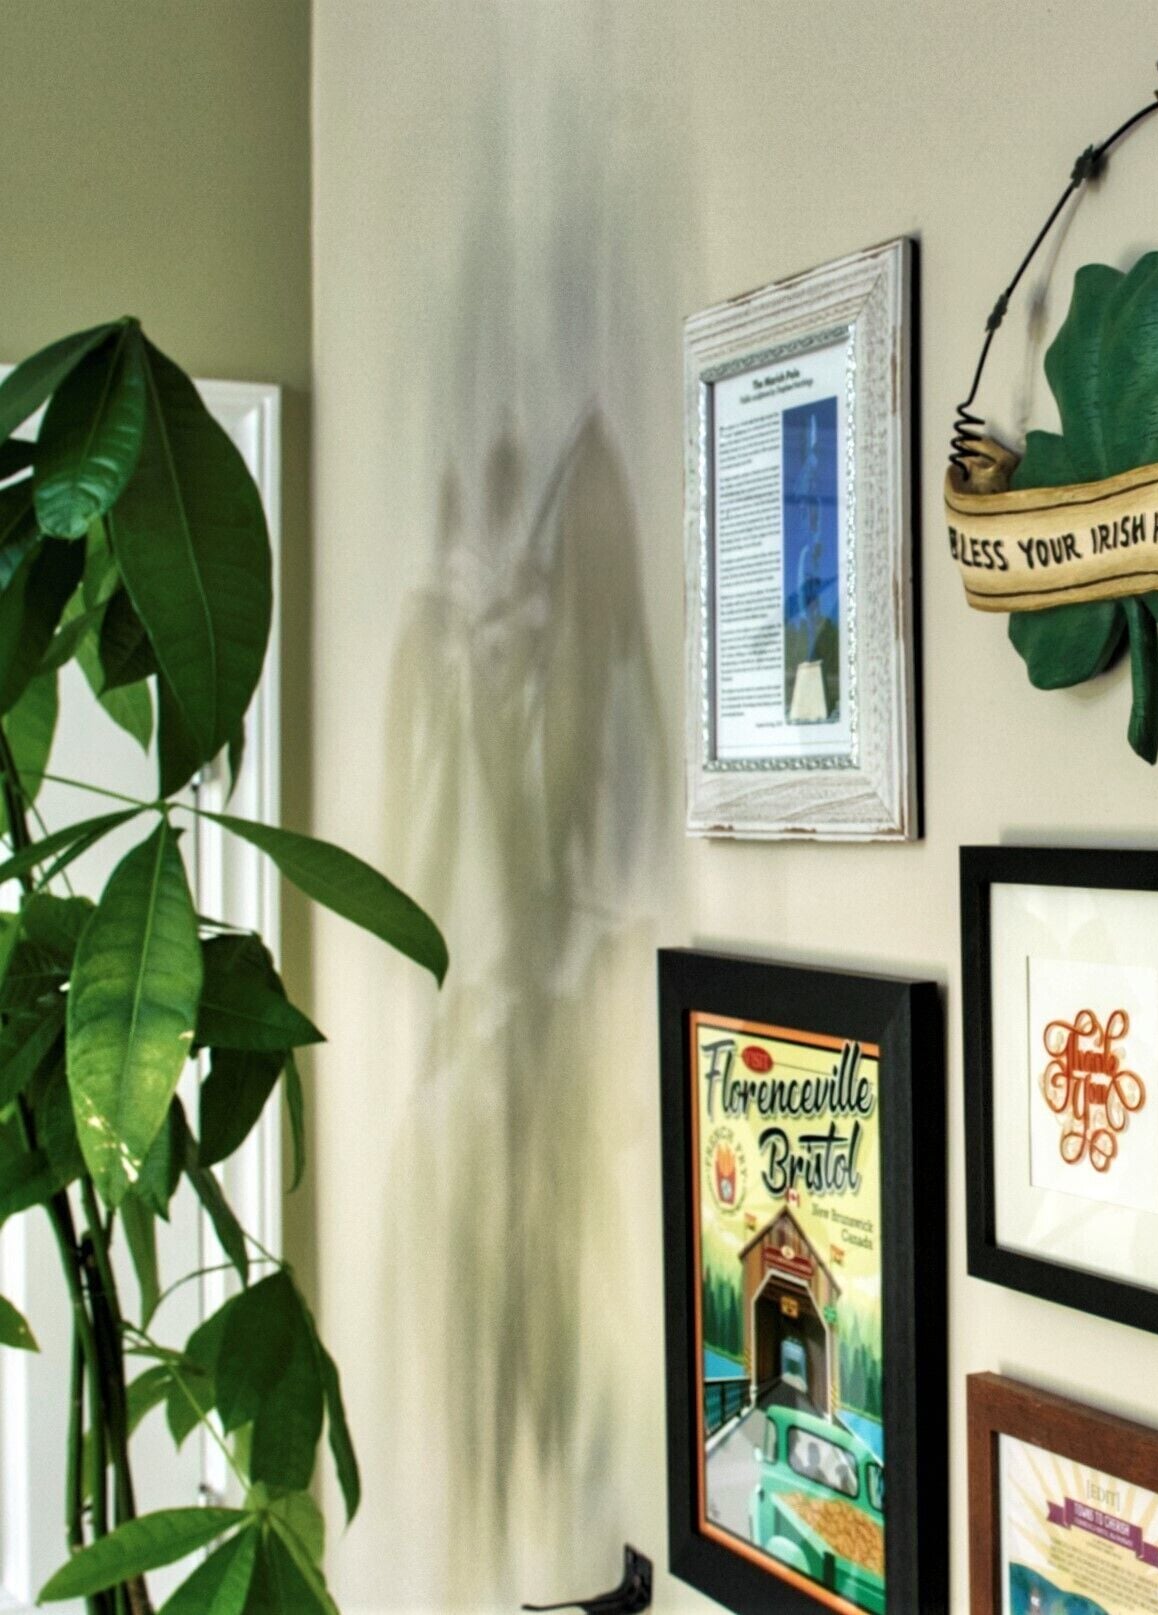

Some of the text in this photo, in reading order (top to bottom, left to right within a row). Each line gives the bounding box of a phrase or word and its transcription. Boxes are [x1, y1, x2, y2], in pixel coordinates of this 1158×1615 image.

[1017, 535, 1082, 569] YOUR
[1091, 512, 1146, 555] IRISH
[702, 1040, 873, 1118] Florenceville
[759, 1120, 861, 1195] Bristol
